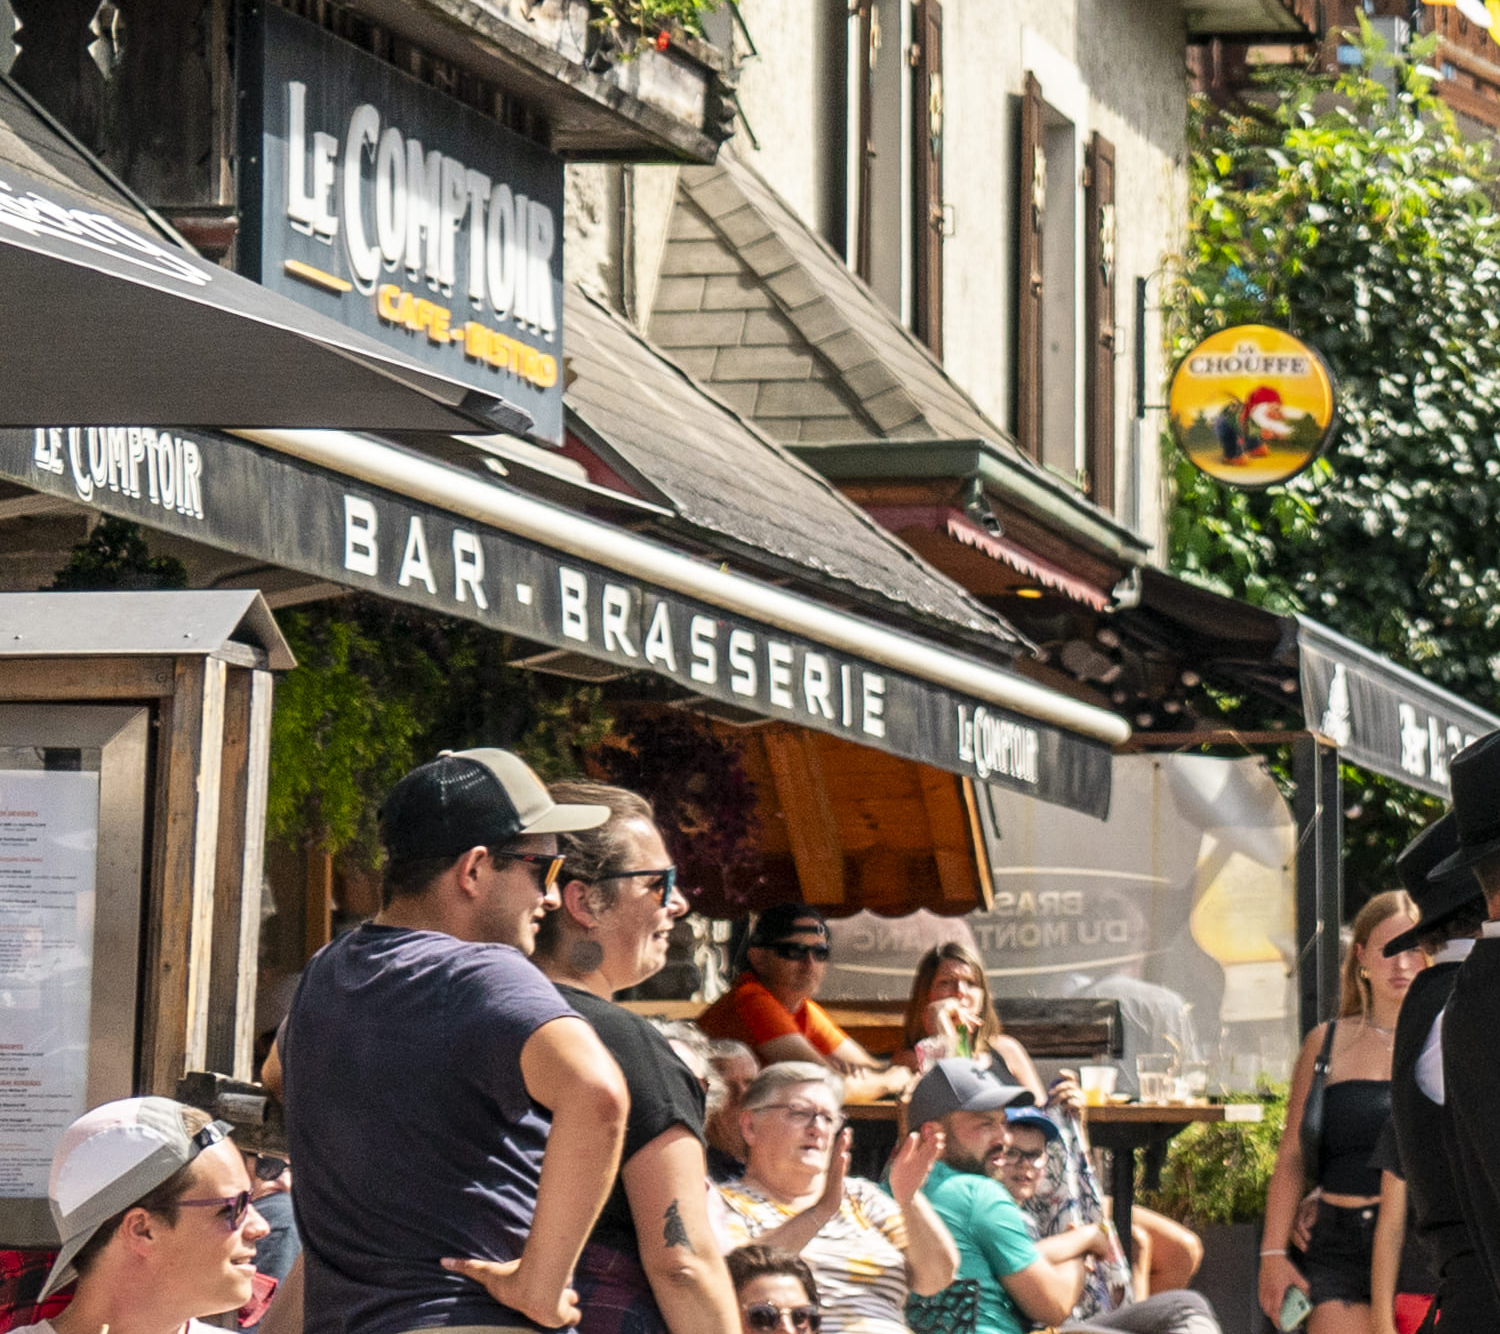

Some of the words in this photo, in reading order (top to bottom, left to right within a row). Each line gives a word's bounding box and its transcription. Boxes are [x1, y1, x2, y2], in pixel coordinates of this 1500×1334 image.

[287, 81, 338, 245] LE
[344, 103, 558, 343] COMPTOIR
[1188, 355, 1307, 375] CHOUFFE
[67, 427, 205, 521] COMPTOIR
[344, 494, 489, 610] BAR
[559, 565, 887, 738] BRASSERIE
